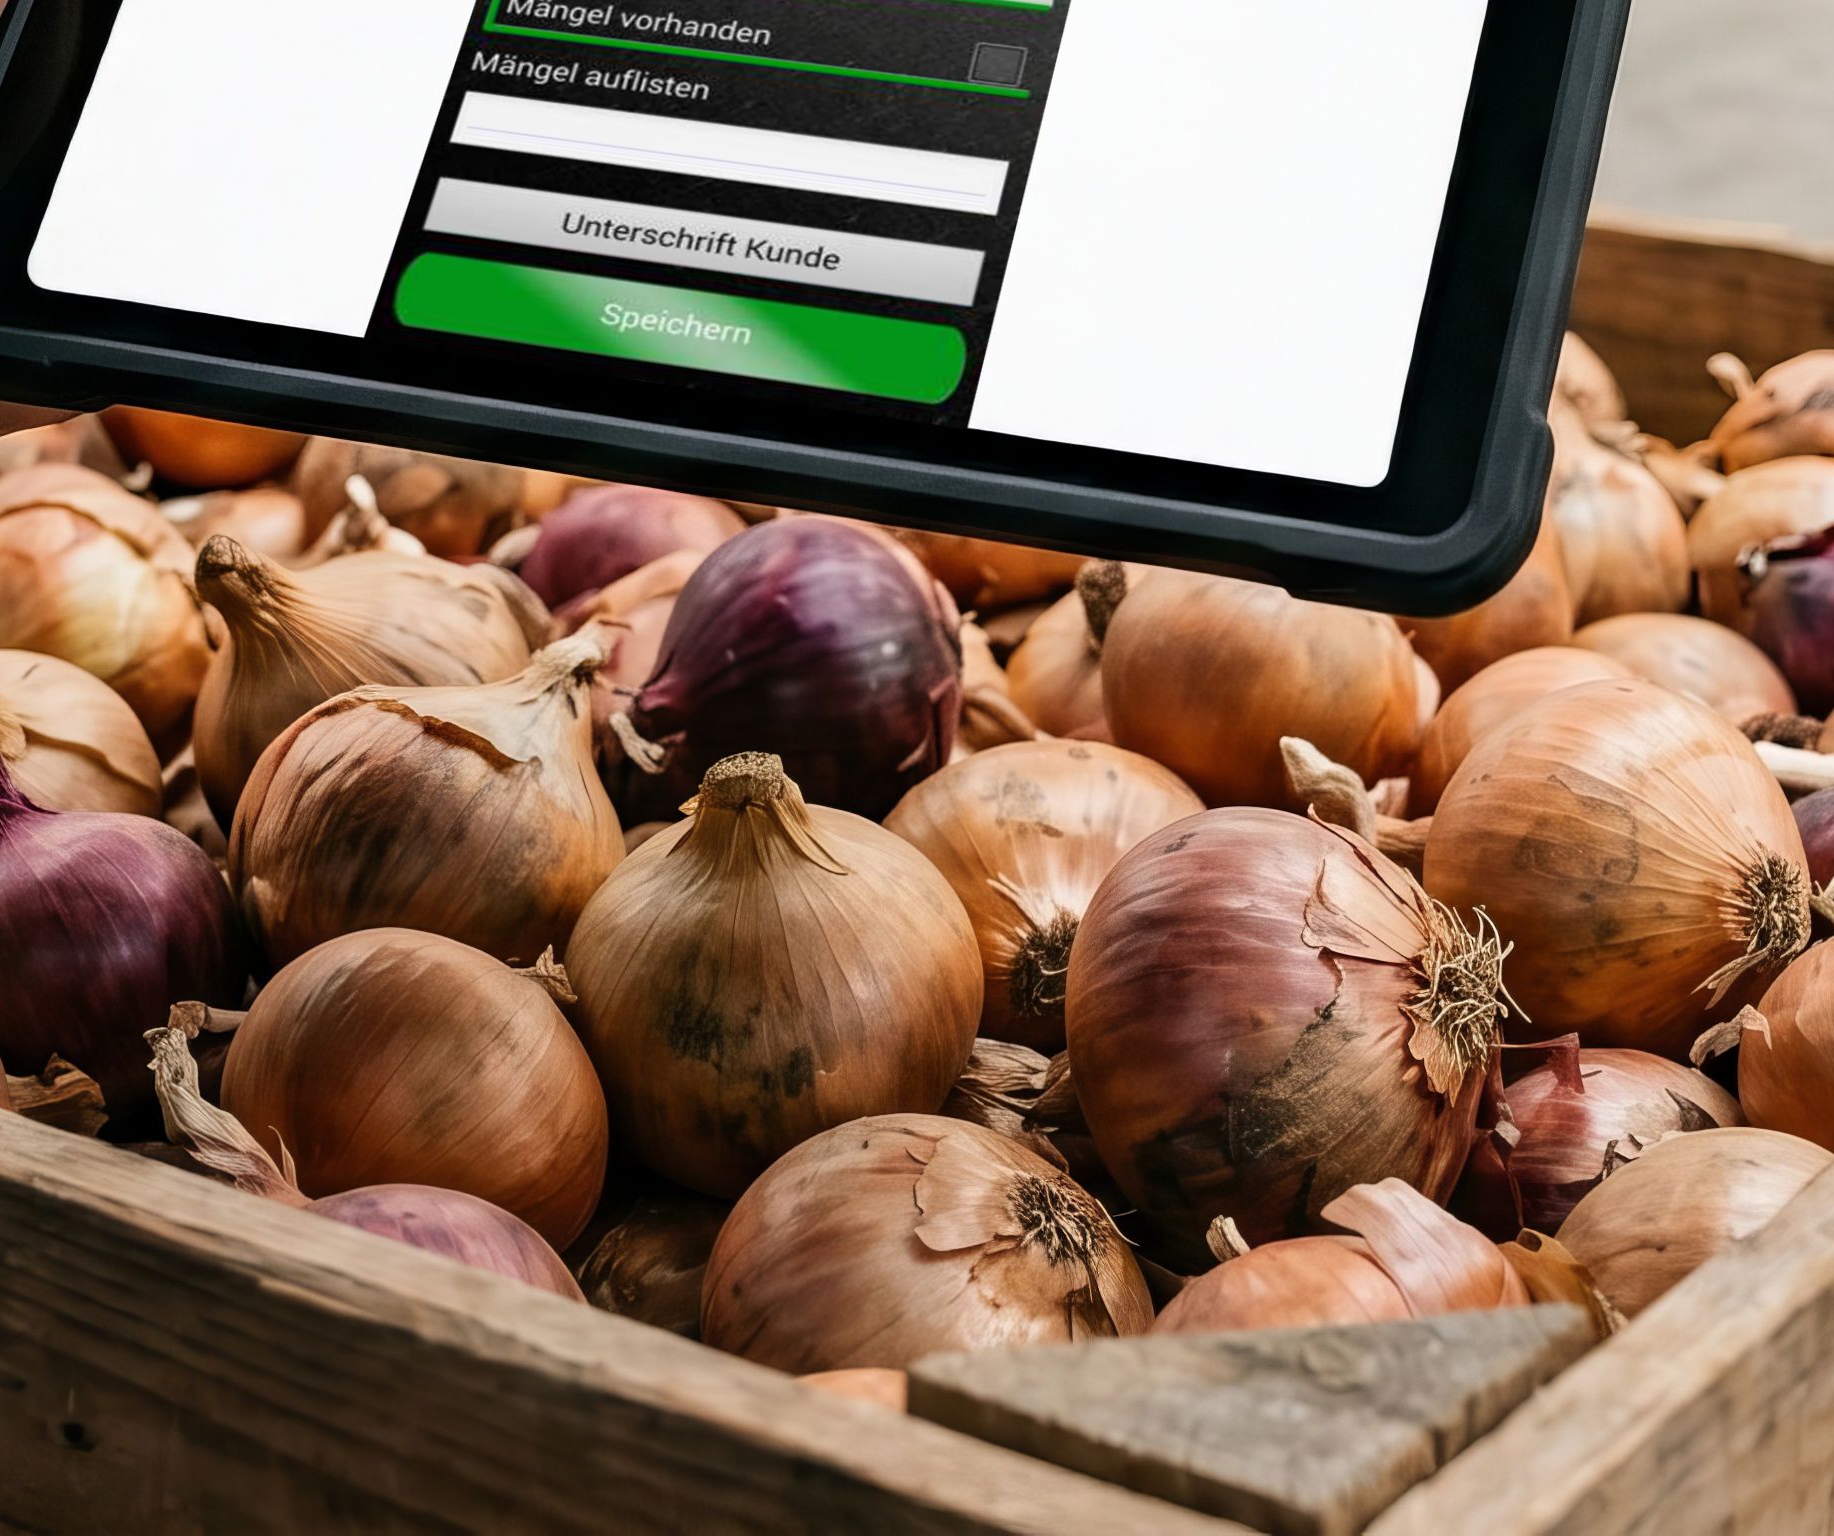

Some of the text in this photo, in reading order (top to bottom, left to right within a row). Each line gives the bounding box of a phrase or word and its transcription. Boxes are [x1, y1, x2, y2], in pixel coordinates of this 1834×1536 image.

[621, 12, 771, 45] vorhanden
[471, 51, 710, 100] Mängel auflisten
[561, 213, 841, 270] Unterschrift Kunde
[600, 303, 752, 345] Speichern
